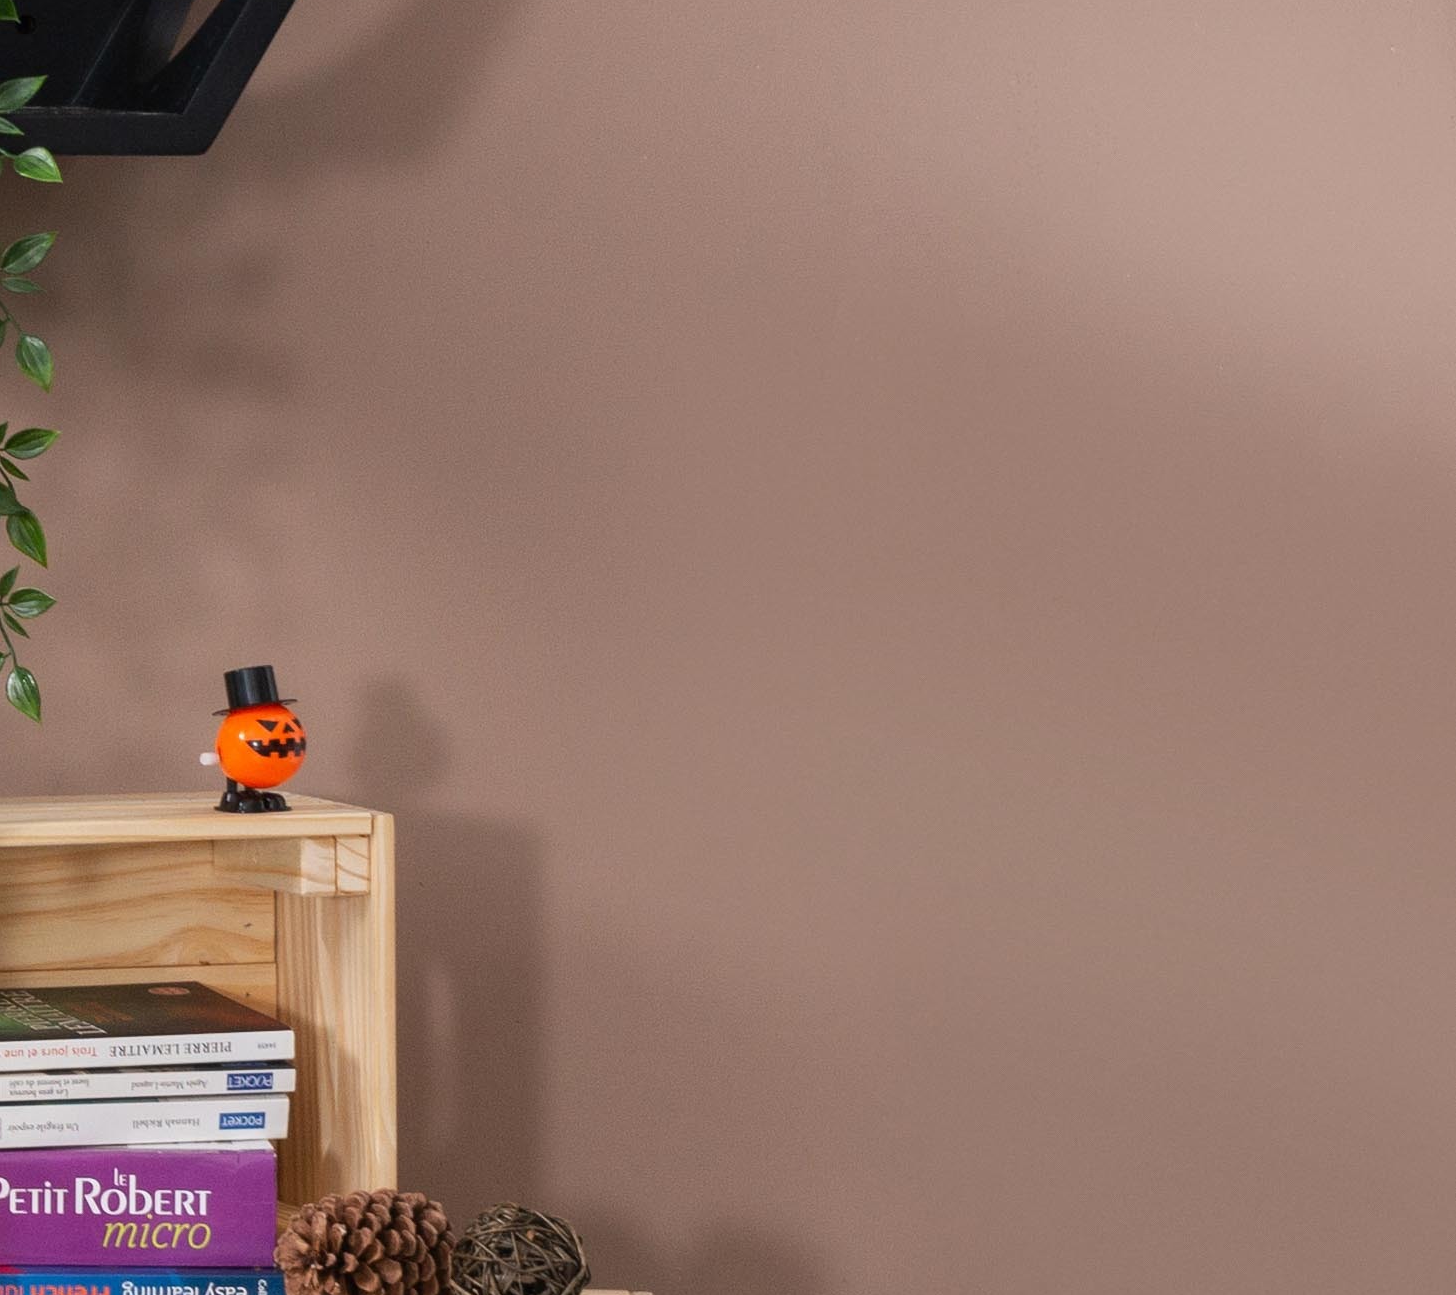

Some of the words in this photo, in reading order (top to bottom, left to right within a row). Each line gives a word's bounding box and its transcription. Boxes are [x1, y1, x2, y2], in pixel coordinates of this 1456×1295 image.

[41, 1046, 68, 1058] jours
[72, 1046, 98, 1058] Trois
[109, 1043, 180, 1057] LEMAITRE
[183, 1041, 232, 1054] PIERRE
[4, 1050, 23, 1058] une
[27, 1049, 38, 1059] et
[228, 1073, 273, 1089] POCKET
[102, 1213, 212, 1249] micro
